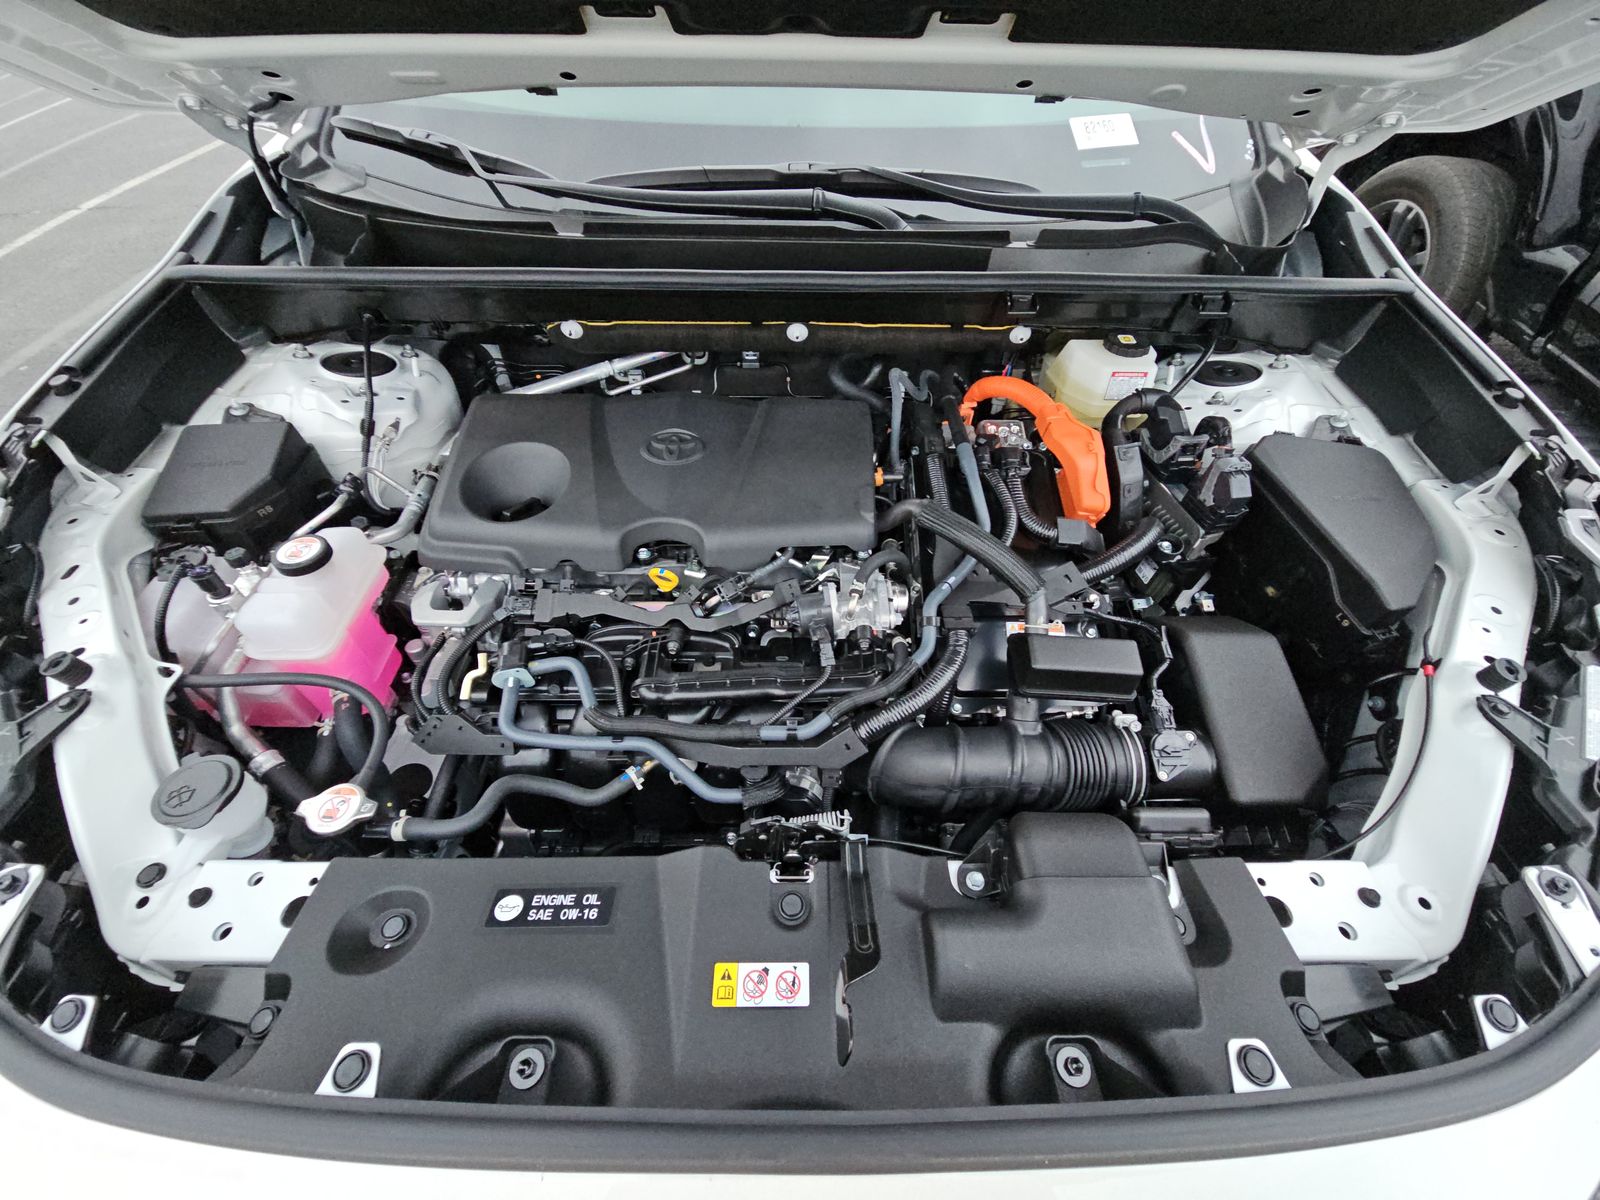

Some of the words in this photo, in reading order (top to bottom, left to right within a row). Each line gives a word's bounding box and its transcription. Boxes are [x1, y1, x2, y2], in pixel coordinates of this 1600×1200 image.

[531, 894, 576, 906] ENGINE
[582, 893, 602, 905] OIL
[527, 908, 554, 921] SAE
[560, 907, 599, 920] 0W-16
